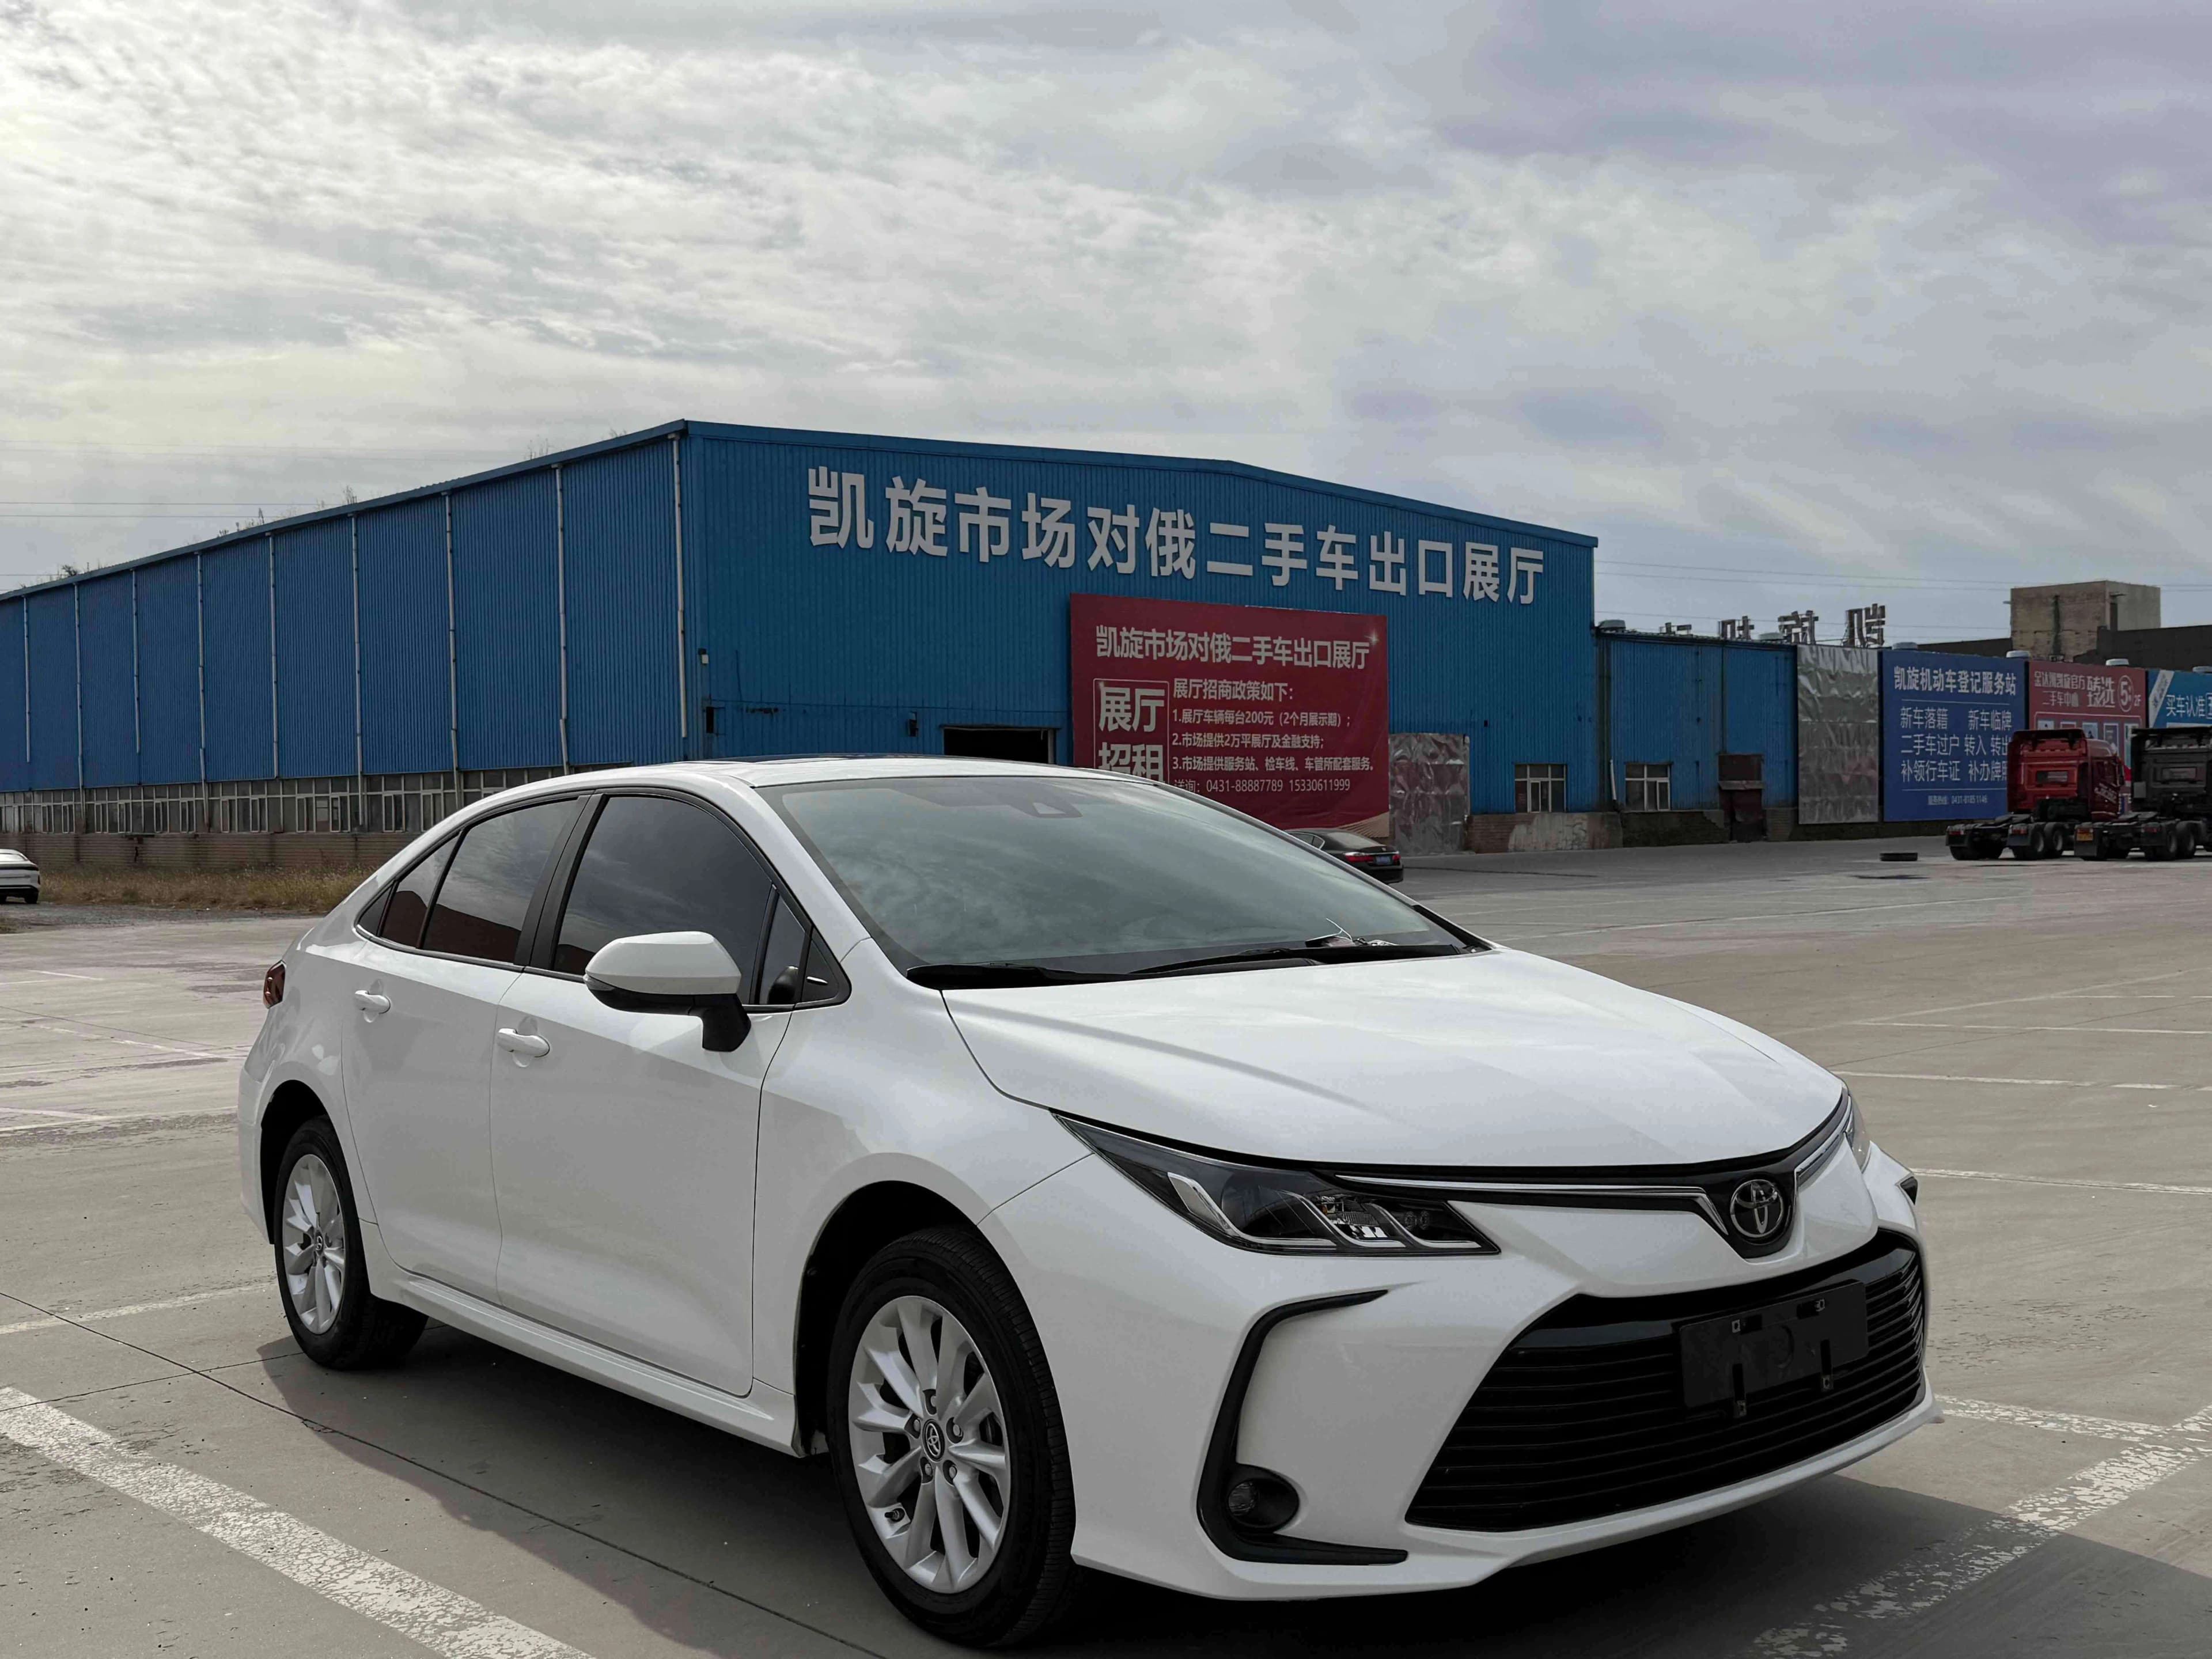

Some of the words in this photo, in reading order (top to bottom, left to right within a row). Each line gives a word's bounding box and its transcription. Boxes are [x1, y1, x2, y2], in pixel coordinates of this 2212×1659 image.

[808, 465, 1544, 604] 凯旋市场对俄二手车出口展厅
[1096, 625, 1370, 669] 凯旋市场对俄二手车出口展厅
[1894, 666, 2016, 696] 凯旋机动车登记服务站
[1099, 687, 1165, 732] 展厅
[1900, 707, 1948, 730] 新车落籍
[1968, 709, 2012, 731] 新车临牌
[1900, 733, 1960, 756] 二手车过户
[1964, 734, 1987, 756] 转入
[1099, 742, 1165, 782] 招租
[1900, 760, 1961, 782] 补领行车证
[1207, 779, 1283, 792] 0431-88887789
[1289, 779, 1350, 791] 15330611999
